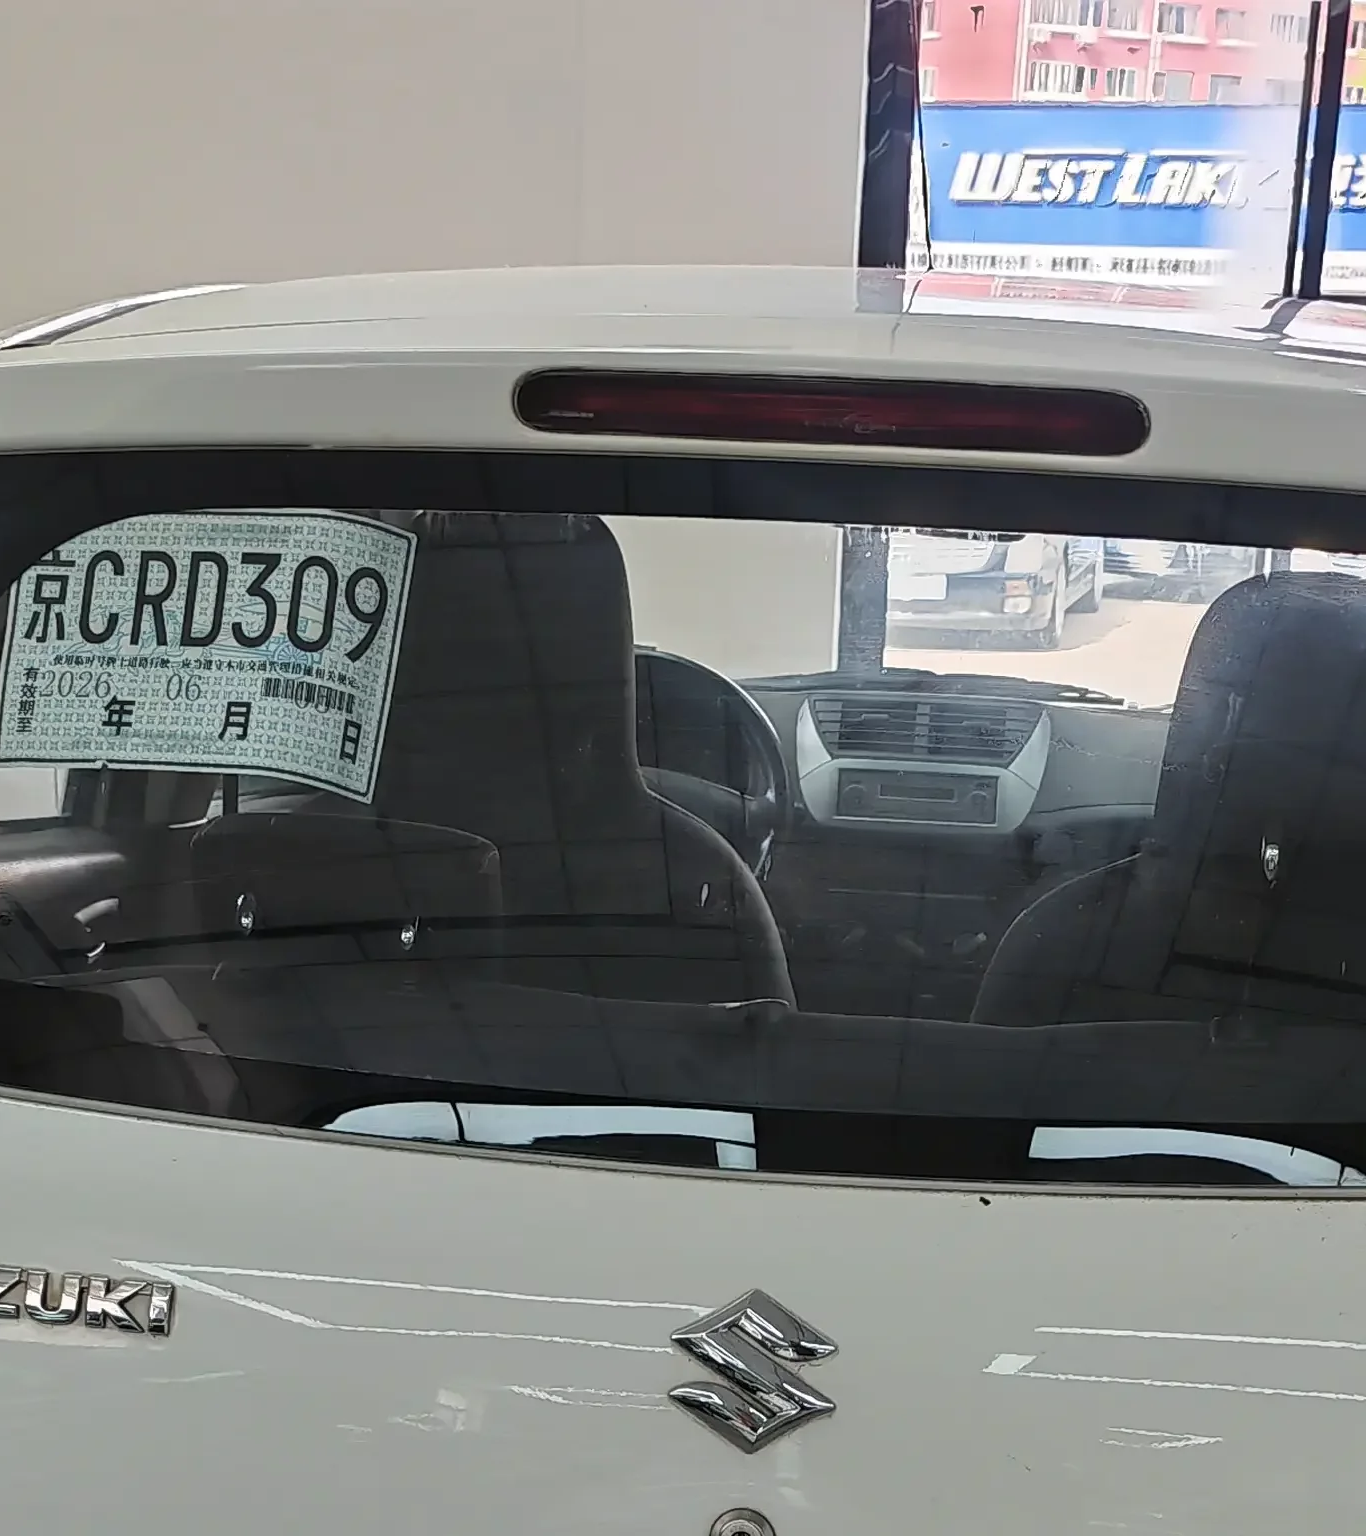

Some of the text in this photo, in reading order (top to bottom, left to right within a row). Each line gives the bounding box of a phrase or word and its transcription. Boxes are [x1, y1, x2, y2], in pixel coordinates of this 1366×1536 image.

[948, 149, 1119, 208] WEST
[23, 549, 389, 662] 京CRD309
[15, 666, 41, 733] 有效期至
[38, 669, 113, 699] 2026
[166, 672, 202, 702] 06
[101, 696, 135, 736] 年
[218, 701, 252, 741] 月
[338, 718, 362, 765] 日
